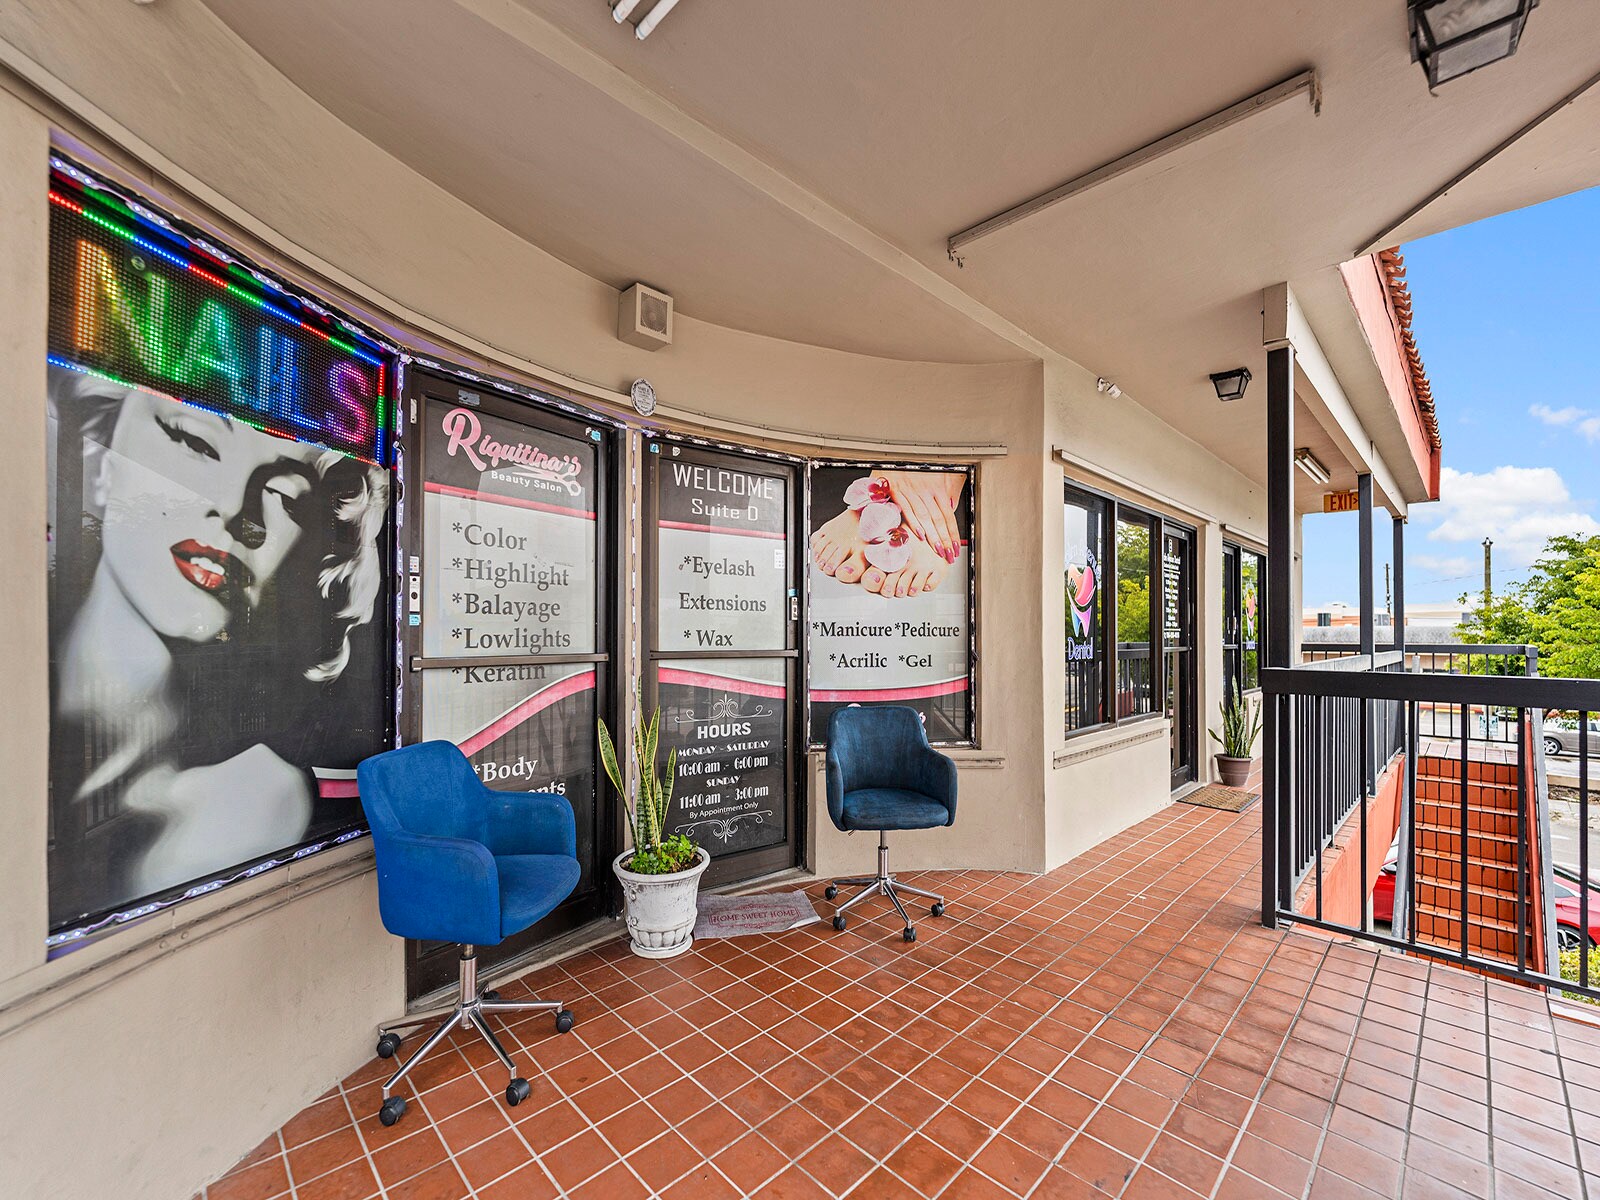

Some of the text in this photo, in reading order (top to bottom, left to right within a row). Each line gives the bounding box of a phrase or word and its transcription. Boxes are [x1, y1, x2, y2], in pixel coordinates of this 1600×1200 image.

[76, 239, 369, 444] NAILS
[442, 407, 582, 475] Riquitina's
[491, 470, 562, 493] Beauty Salon
[672, 463, 774, 499] WELCOME
[691, 498, 740, 519] Suite
[1330, 493, 1354, 511] EXIT
[678, 592, 767, 612] Extensions
[1067, 636, 1094, 660] Dental
[697, 722, 752, 739] HOURS
[677, 745, 717, 757] MONDAY
[726, 740, 771, 752] SATURDAY
[706, 775, 741, 787] SUNDAY
[689, 801, 759, 819] By Appointment Only
[713, 910, 796, 922] HOME SWEET HOME
